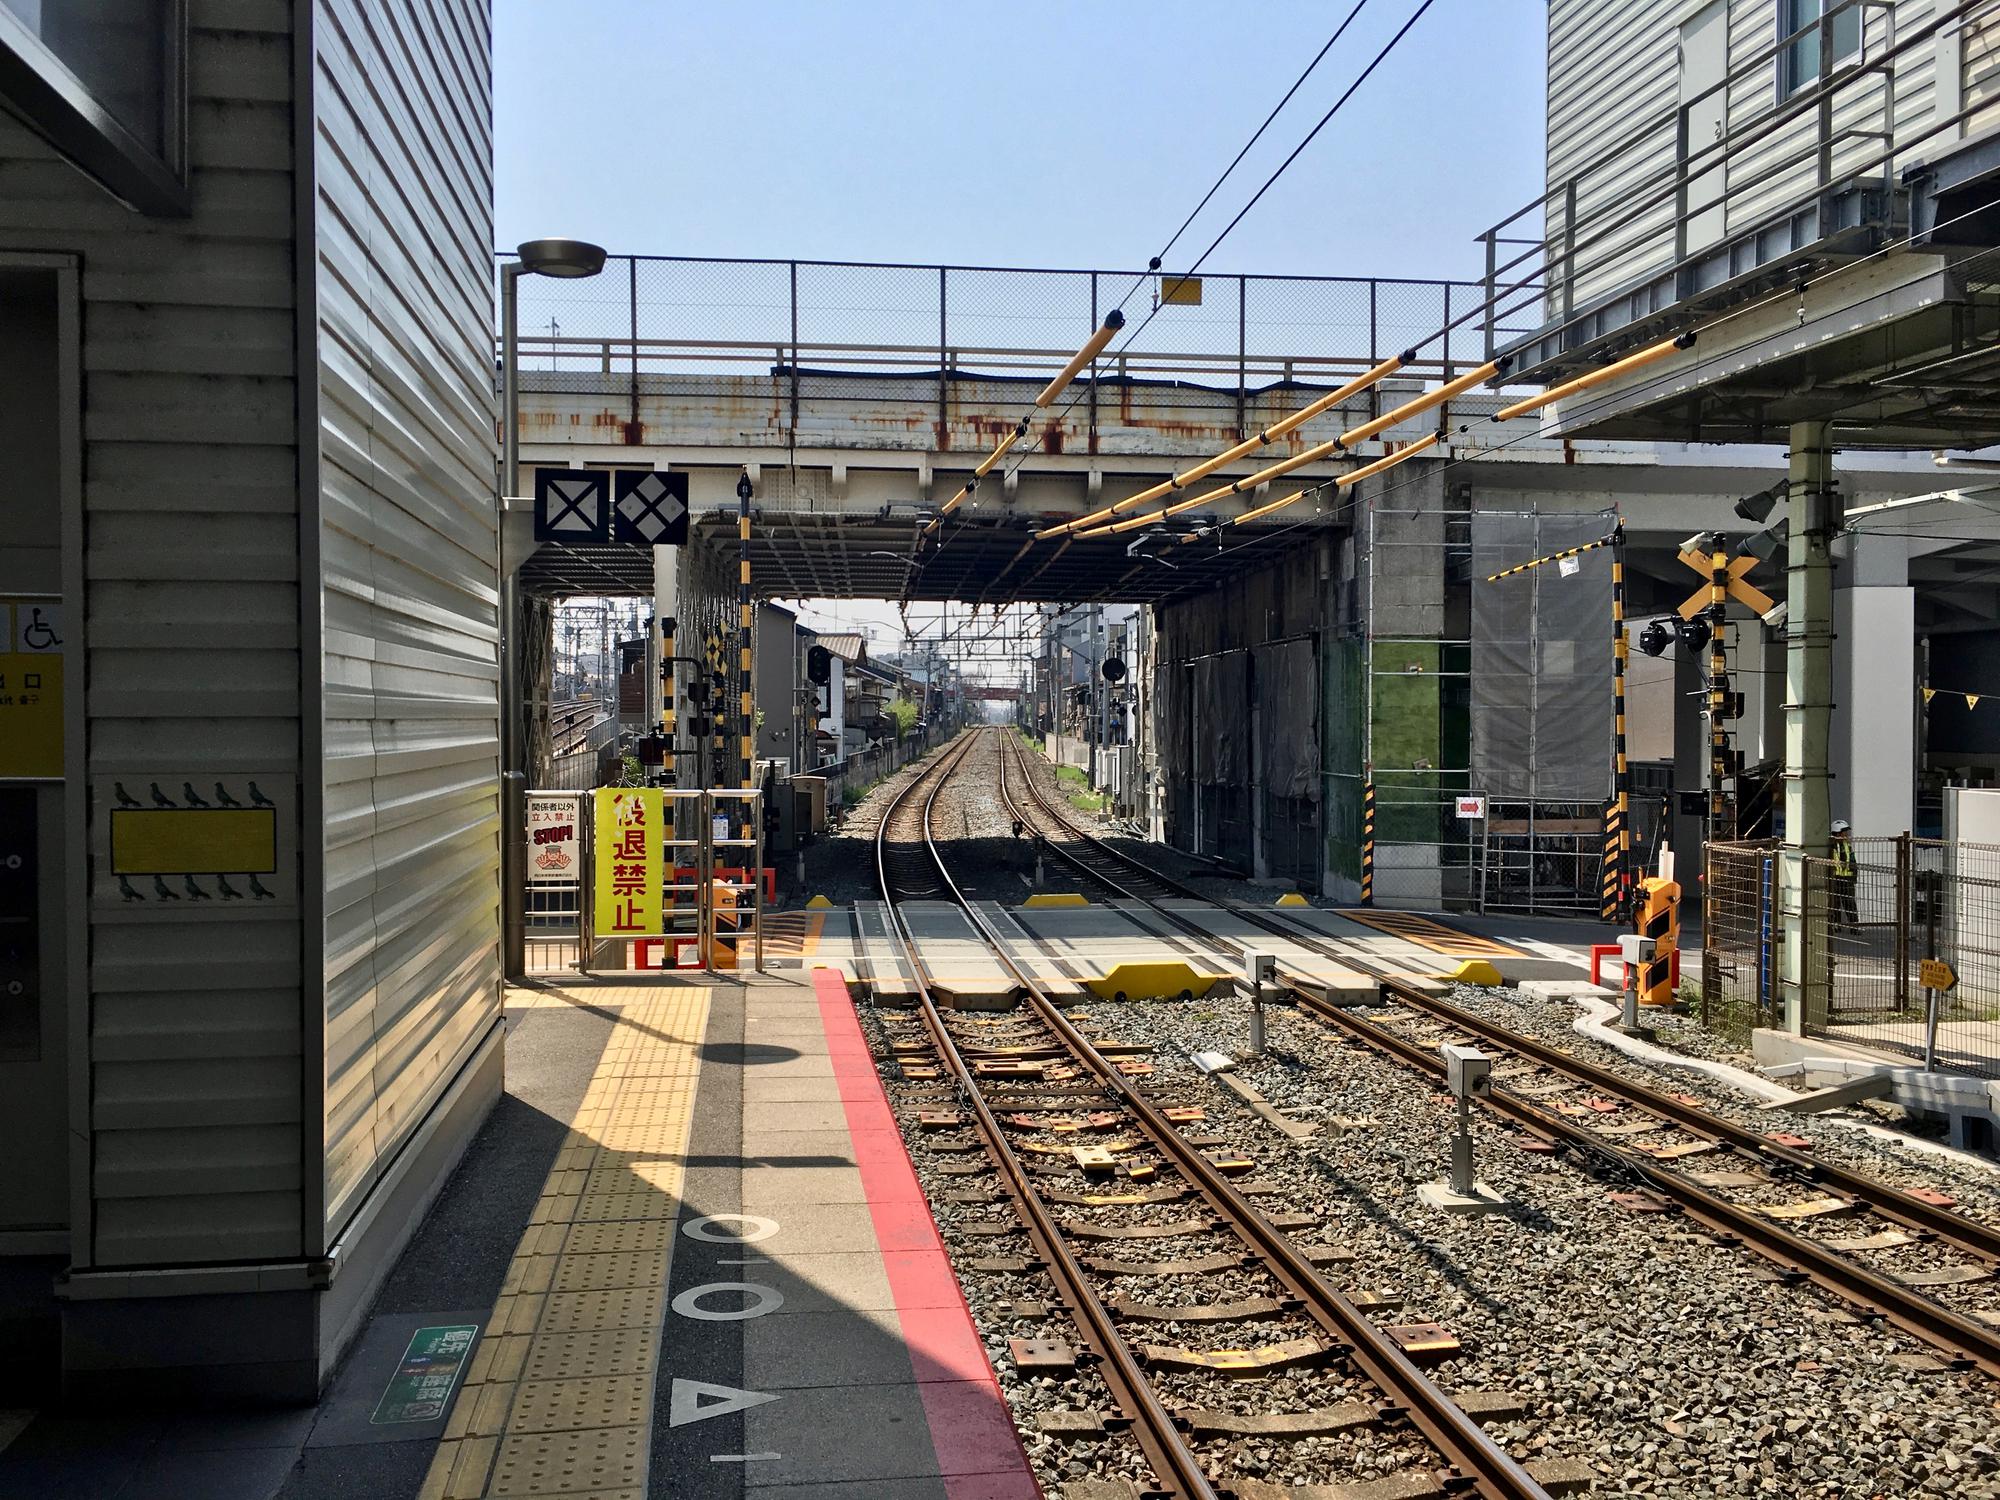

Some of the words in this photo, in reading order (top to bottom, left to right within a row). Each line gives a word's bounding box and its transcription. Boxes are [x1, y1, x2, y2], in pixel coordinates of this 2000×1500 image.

[531, 802, 575, 812] 関係者以外
[531, 812, 575, 822] 立入禁止
[533, 825, 573, 846] STOP!
